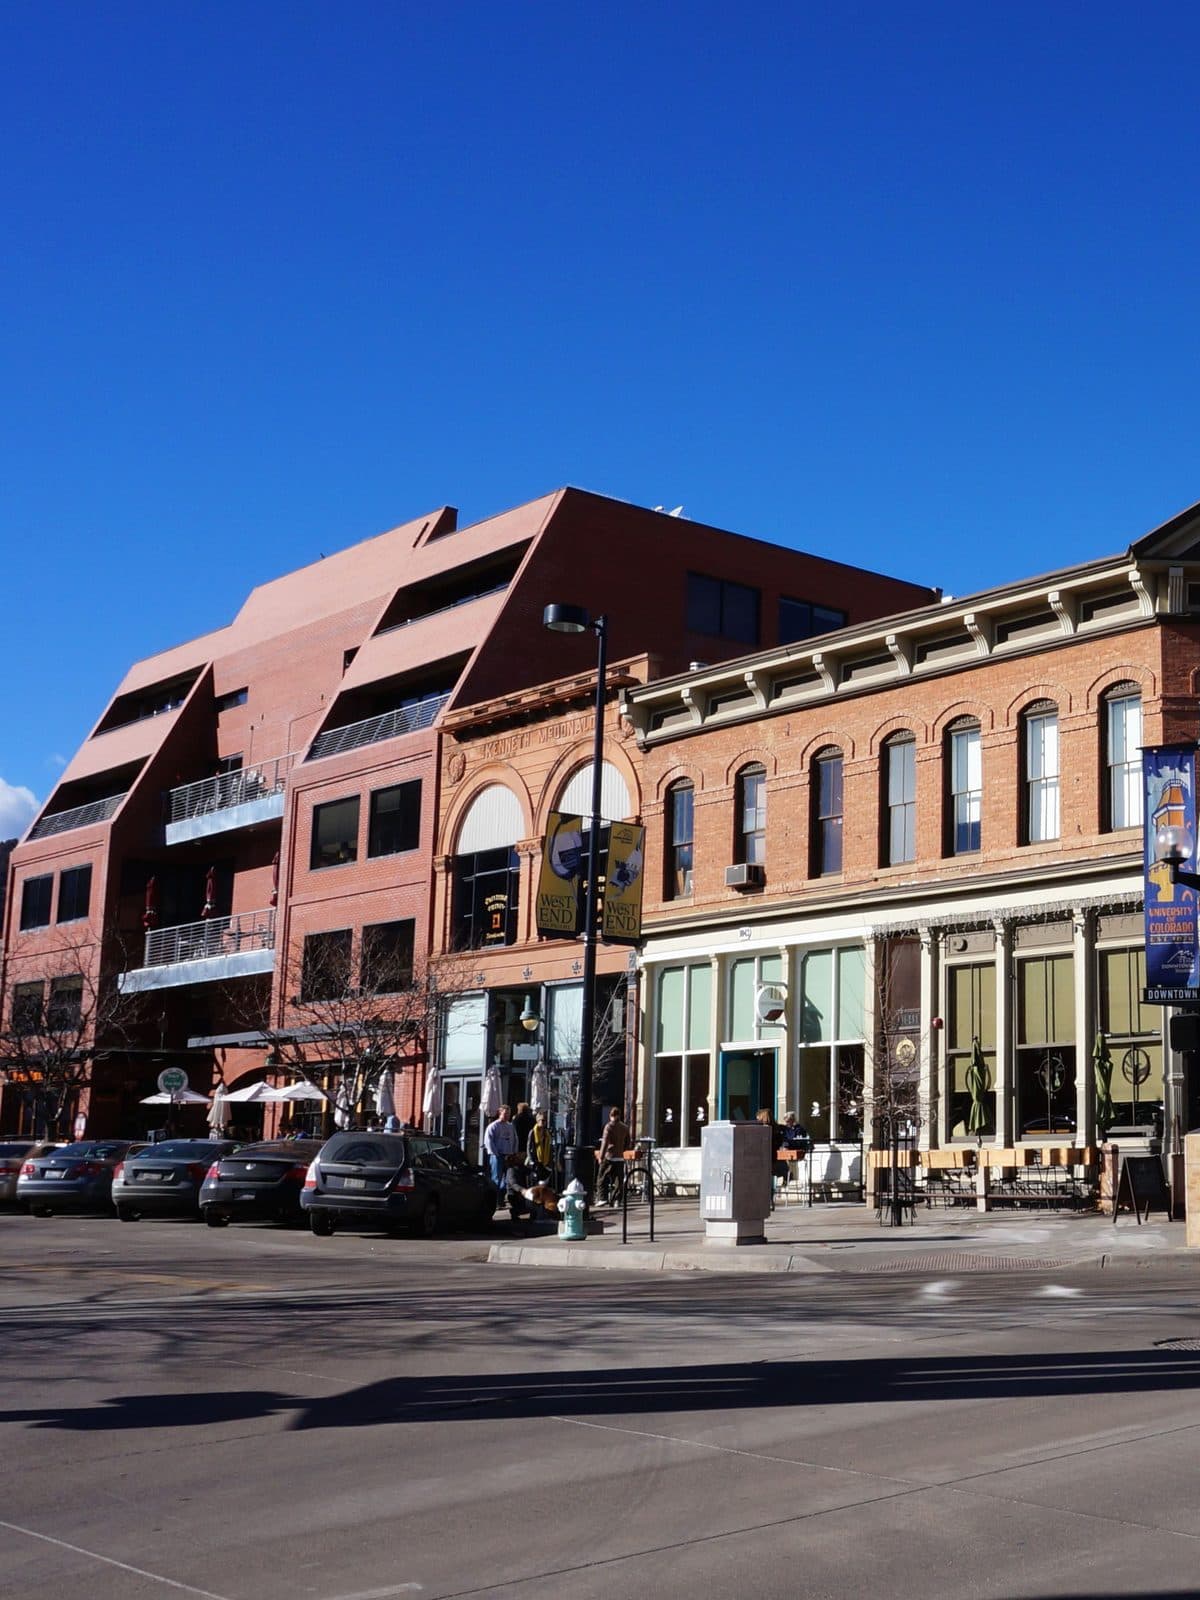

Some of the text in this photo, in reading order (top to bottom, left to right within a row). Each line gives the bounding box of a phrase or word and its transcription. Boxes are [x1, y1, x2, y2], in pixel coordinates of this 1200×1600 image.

[481, 732, 531, 760] KENNETH
[540, 909, 573, 924] END
[1148, 907, 1194, 917] UNIVERSITY
[606, 916, 638, 932] END
[1149, 923, 1195, 934] COLORADO
[1148, 988, 1198, 999] DOWNTOWN
